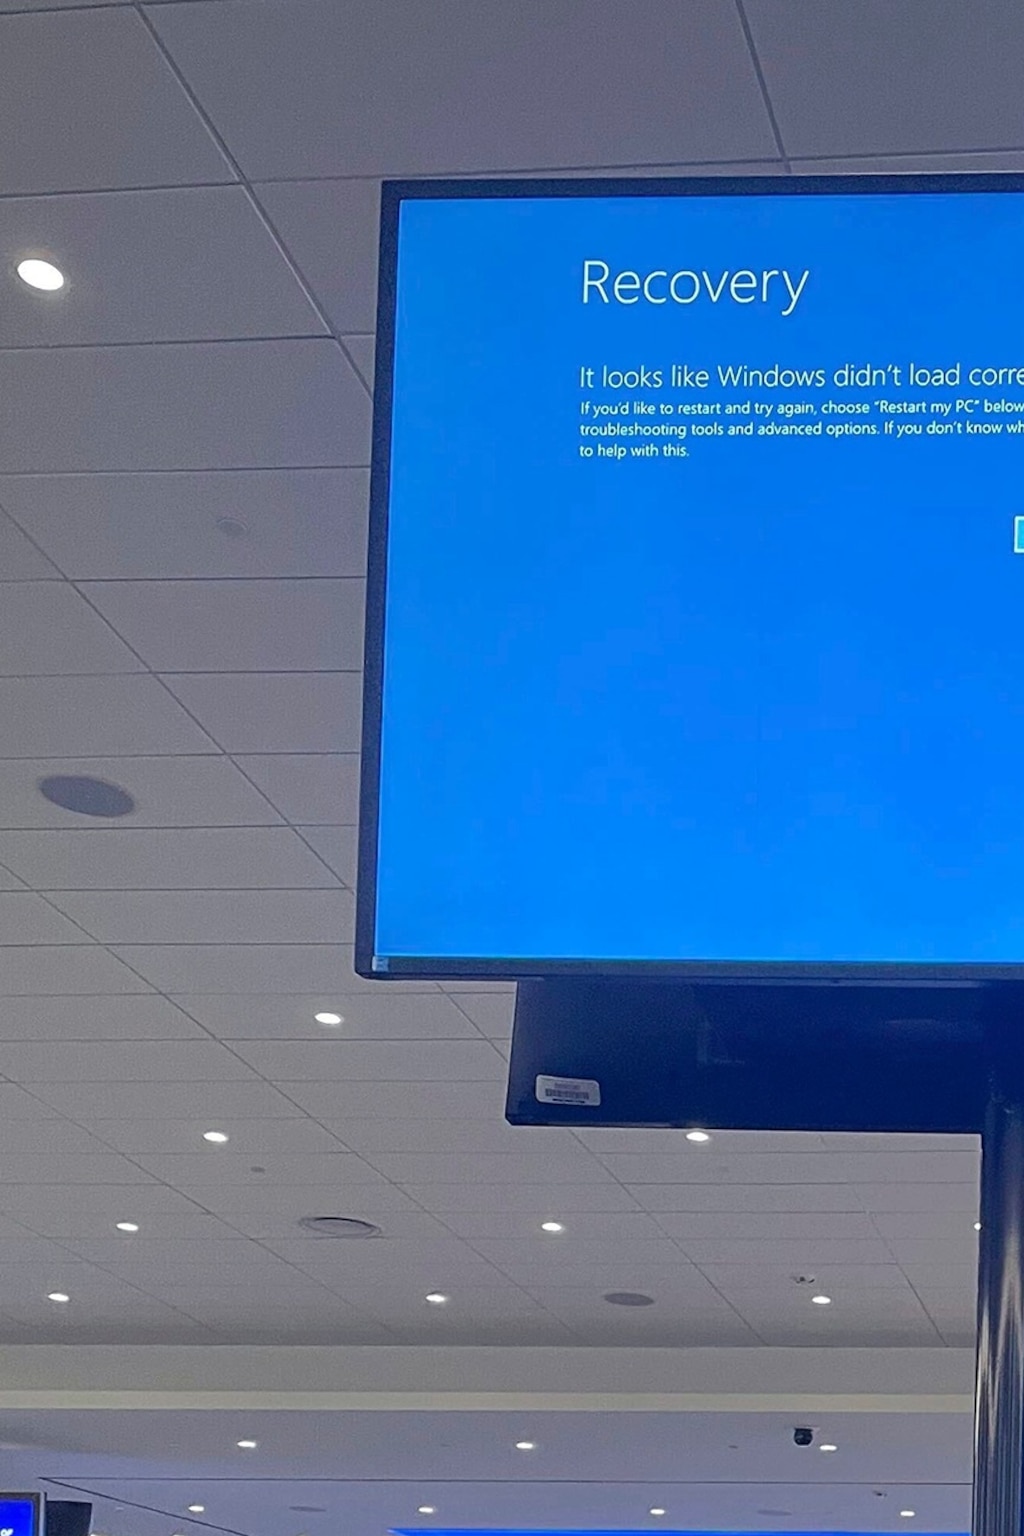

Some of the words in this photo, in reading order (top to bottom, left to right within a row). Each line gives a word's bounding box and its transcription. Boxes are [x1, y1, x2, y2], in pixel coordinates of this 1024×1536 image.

[583, 260, 810, 316] Recovery
[580, 366, 595, 389] It
[602, 364, 663, 389] looks
[671, 364, 710, 389] like
[717, 363, 826, 388] Windows
[833, 363, 902, 388] didn't
[909, 362, 961, 387] load
[580, 400, 591, 415] If
[633, 401, 656, 415] like
[659, 403, 674, 415] to
[677, 402, 722, 415] restart
[724, 400, 751, 415] and
[754, 402, 774, 418] try
[776, 403, 817, 418] again,
[820, 399, 870, 414] choose
[930, 402, 952, 417] my
[579, 422, 687, 440] troubleshooting
[691, 421, 724, 436] tools
[727, 421, 754, 436] and
[757, 421, 823, 436] advanced
[825, 421, 880, 438] options.
[884, 420, 894, 435] If
[896, 424, 923, 438] you
[965, 420, 1004, 435] know
[579, 445, 594, 458] to
[597, 443, 627, 460] help
[630, 443, 659, 457] with
[662, 443, 690, 457] this.
